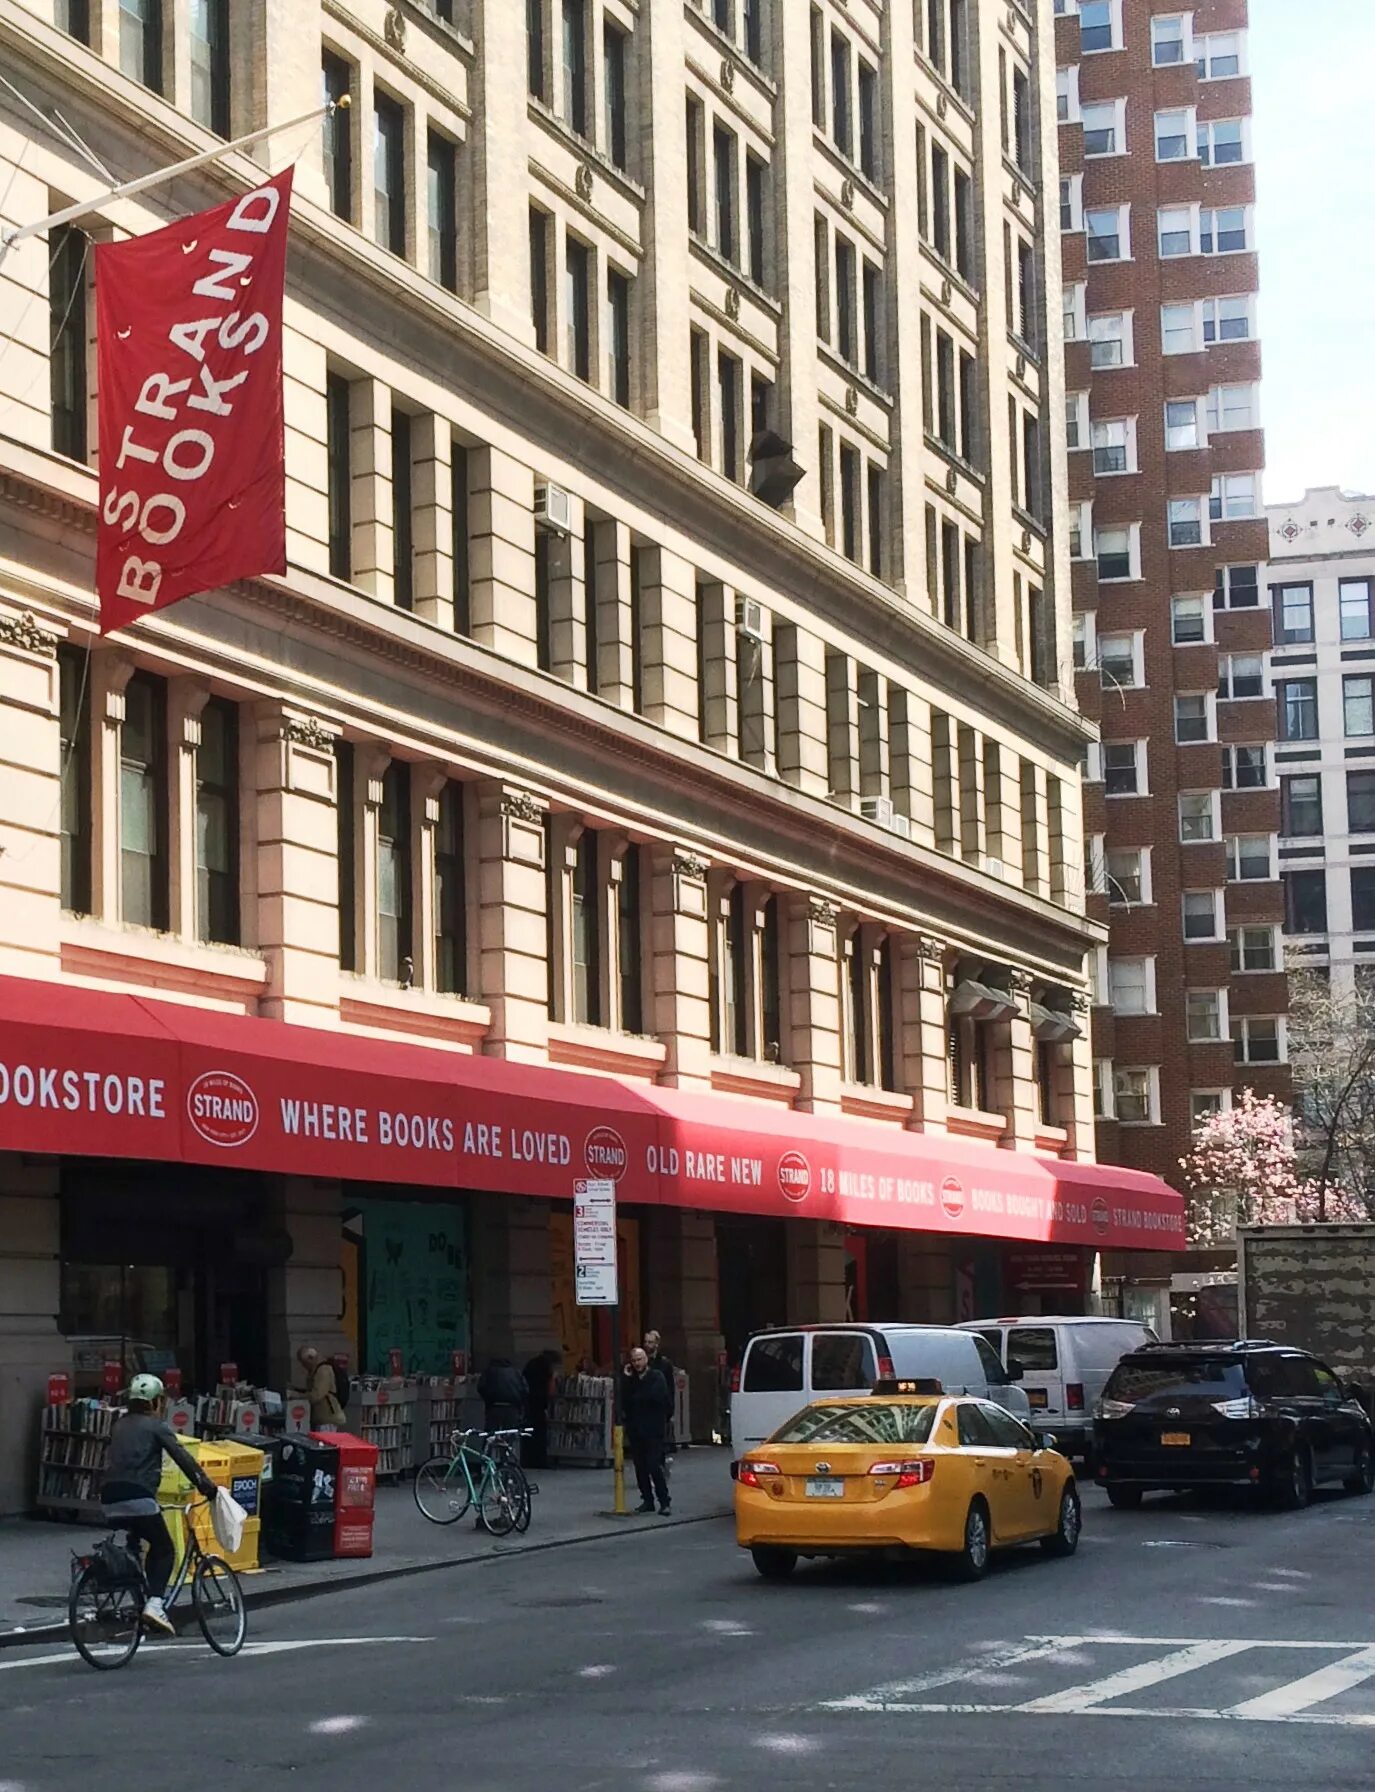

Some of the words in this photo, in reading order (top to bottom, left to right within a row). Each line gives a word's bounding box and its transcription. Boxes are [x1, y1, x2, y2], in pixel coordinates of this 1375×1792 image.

[104, 186, 280, 533] STRAND
[116, 310, 270, 606] BOOKS
[194, 1093, 253, 1123] STRAND
[280, 1098, 368, 1143] WHERE
[379, 1111, 454, 1151] BOOKS
[464, 1122, 502, 1157] ARE
[511, 1129, 570, 1165] LOVED
[588, 1144, 625, 1167] STRAND
[647, 1145, 679, 1175] OLD
[685, 1150, 725, 1182] RARE
[731, 1156, 762, 1185] NEW
[780, 1167, 809, 1186] STRAND
[820, 1167, 835, 1194] 18
[838, 1169, 875, 1200] MILES
[879, 1175, 895, 1201] OF
[897, 1178, 934, 1206] BOOKS
[971, 1189, 1004, 1212] BOOKS
[1007, 1193, 1042, 1219] BOUGHT
[1065, 1201, 1087, 1223] SOLD
[1113, 1208, 1142, 1228] STRAND
[1143, 1211, 1183, 1232] BOOKSTORE
